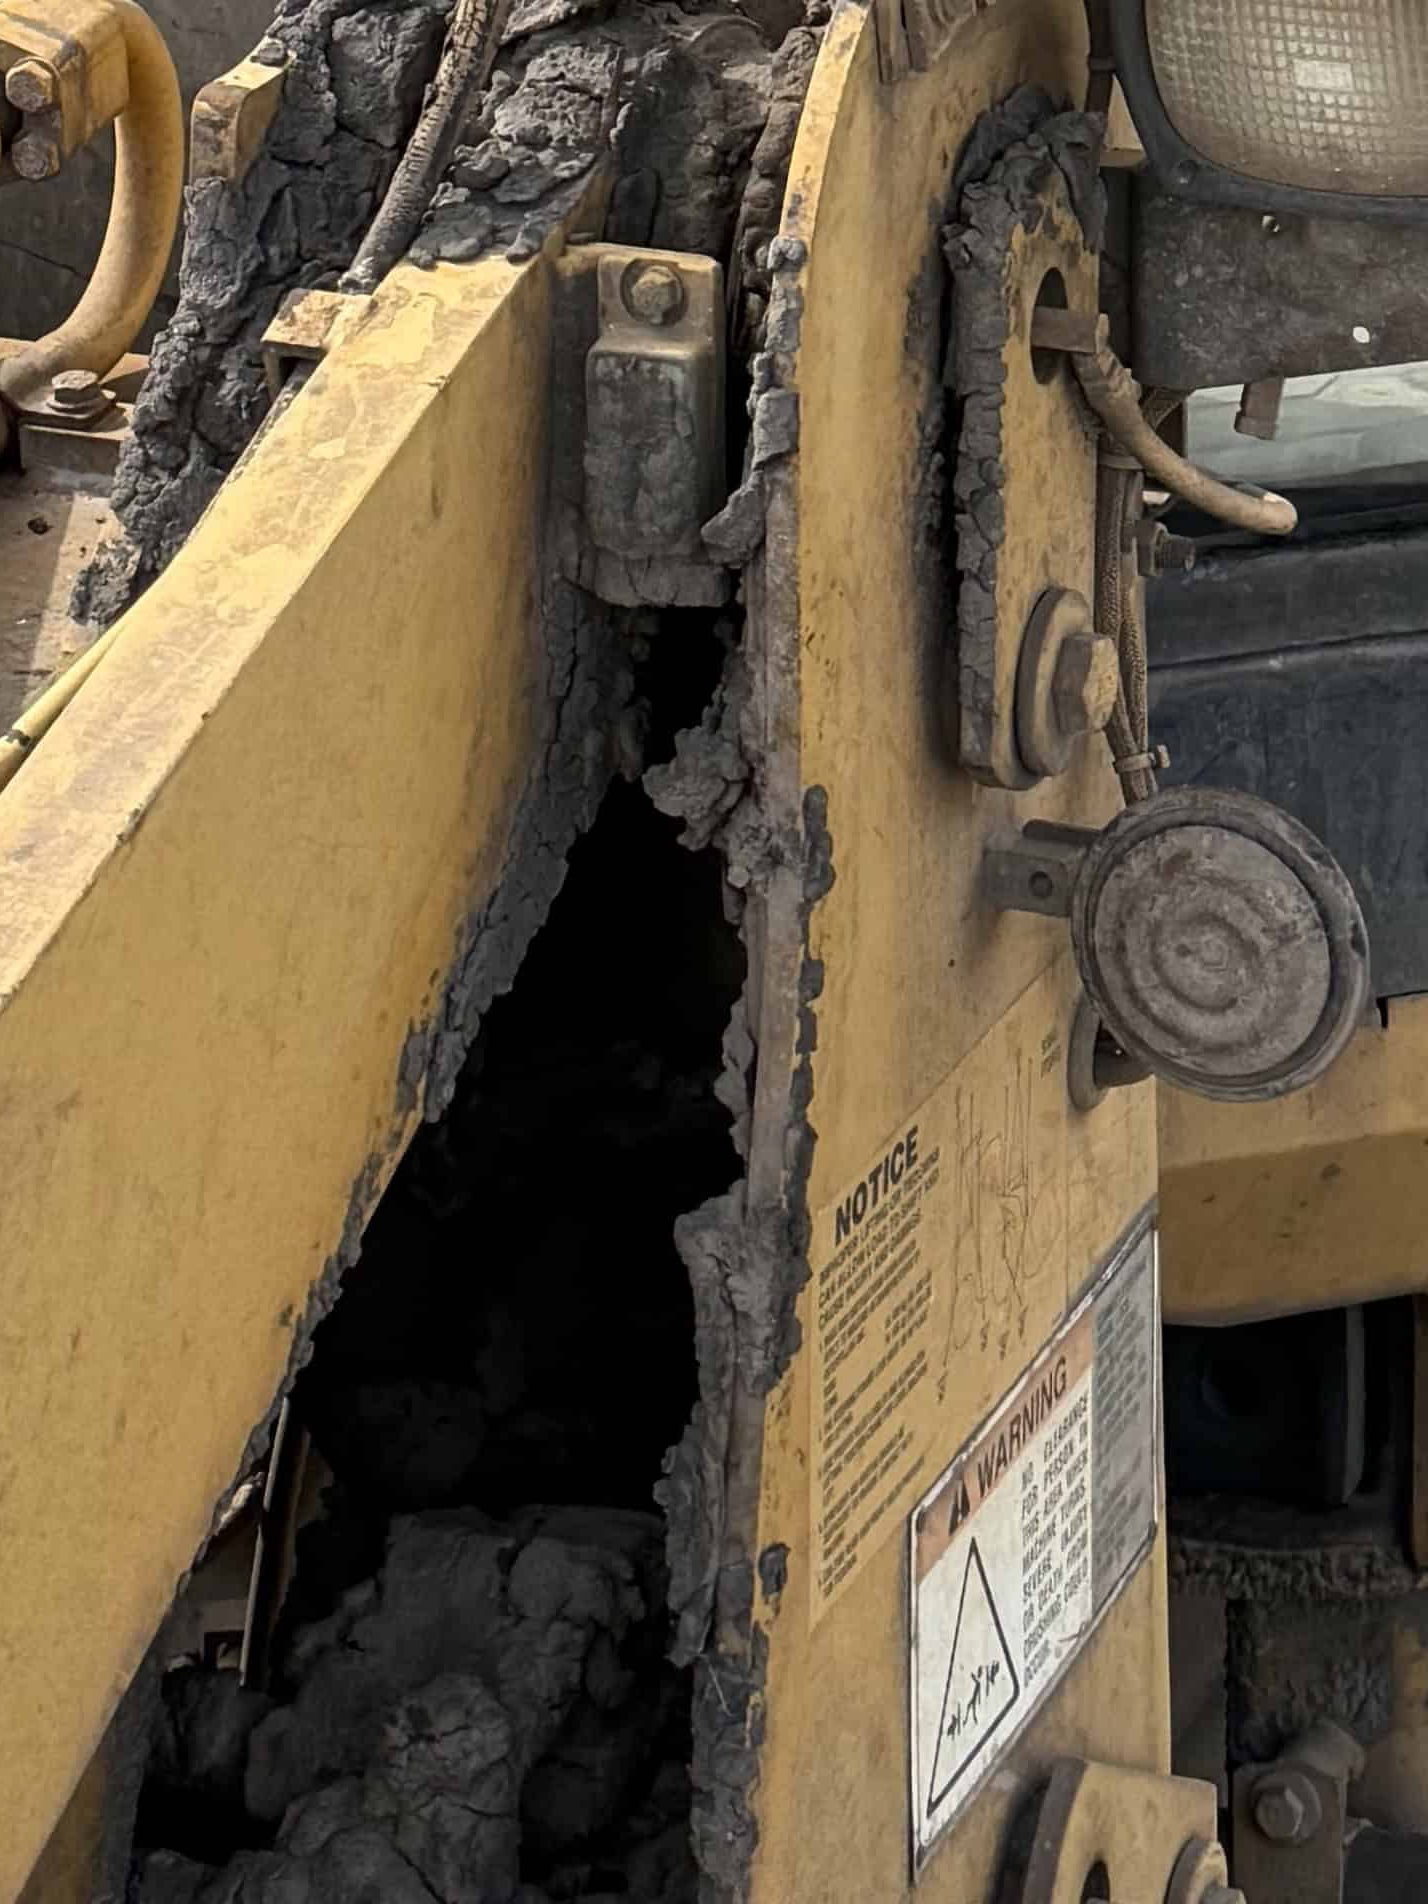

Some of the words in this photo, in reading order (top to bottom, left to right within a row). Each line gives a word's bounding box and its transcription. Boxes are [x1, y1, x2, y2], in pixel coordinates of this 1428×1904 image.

[835, 1124, 919, 1247] NOTICE
[977, 1355, 1068, 1499] WARNING
[1022, 1461, 1034, 1492] NO
[1044, 1394, 1089, 1464] CLEARANCE
[1022, 1484, 1039, 1520] FOR
[1044, 1438, 1074, 1493] PERSON
[1022, 1510, 1040, 1546] THIS
[1044, 1479, 1064, 1518] AREA
[1066, 1447, 1089, 1489] WHEN
[1022, 1513, 1057, 1577] MACHINE
[1023, 1548, 1053, 1605] SEVERE
[1023, 1601, 1035, 1635] OR
[1037, 1564, 1064, 1613] DEATH
[1023, 1593, 1063, 1660] CRUSHING
